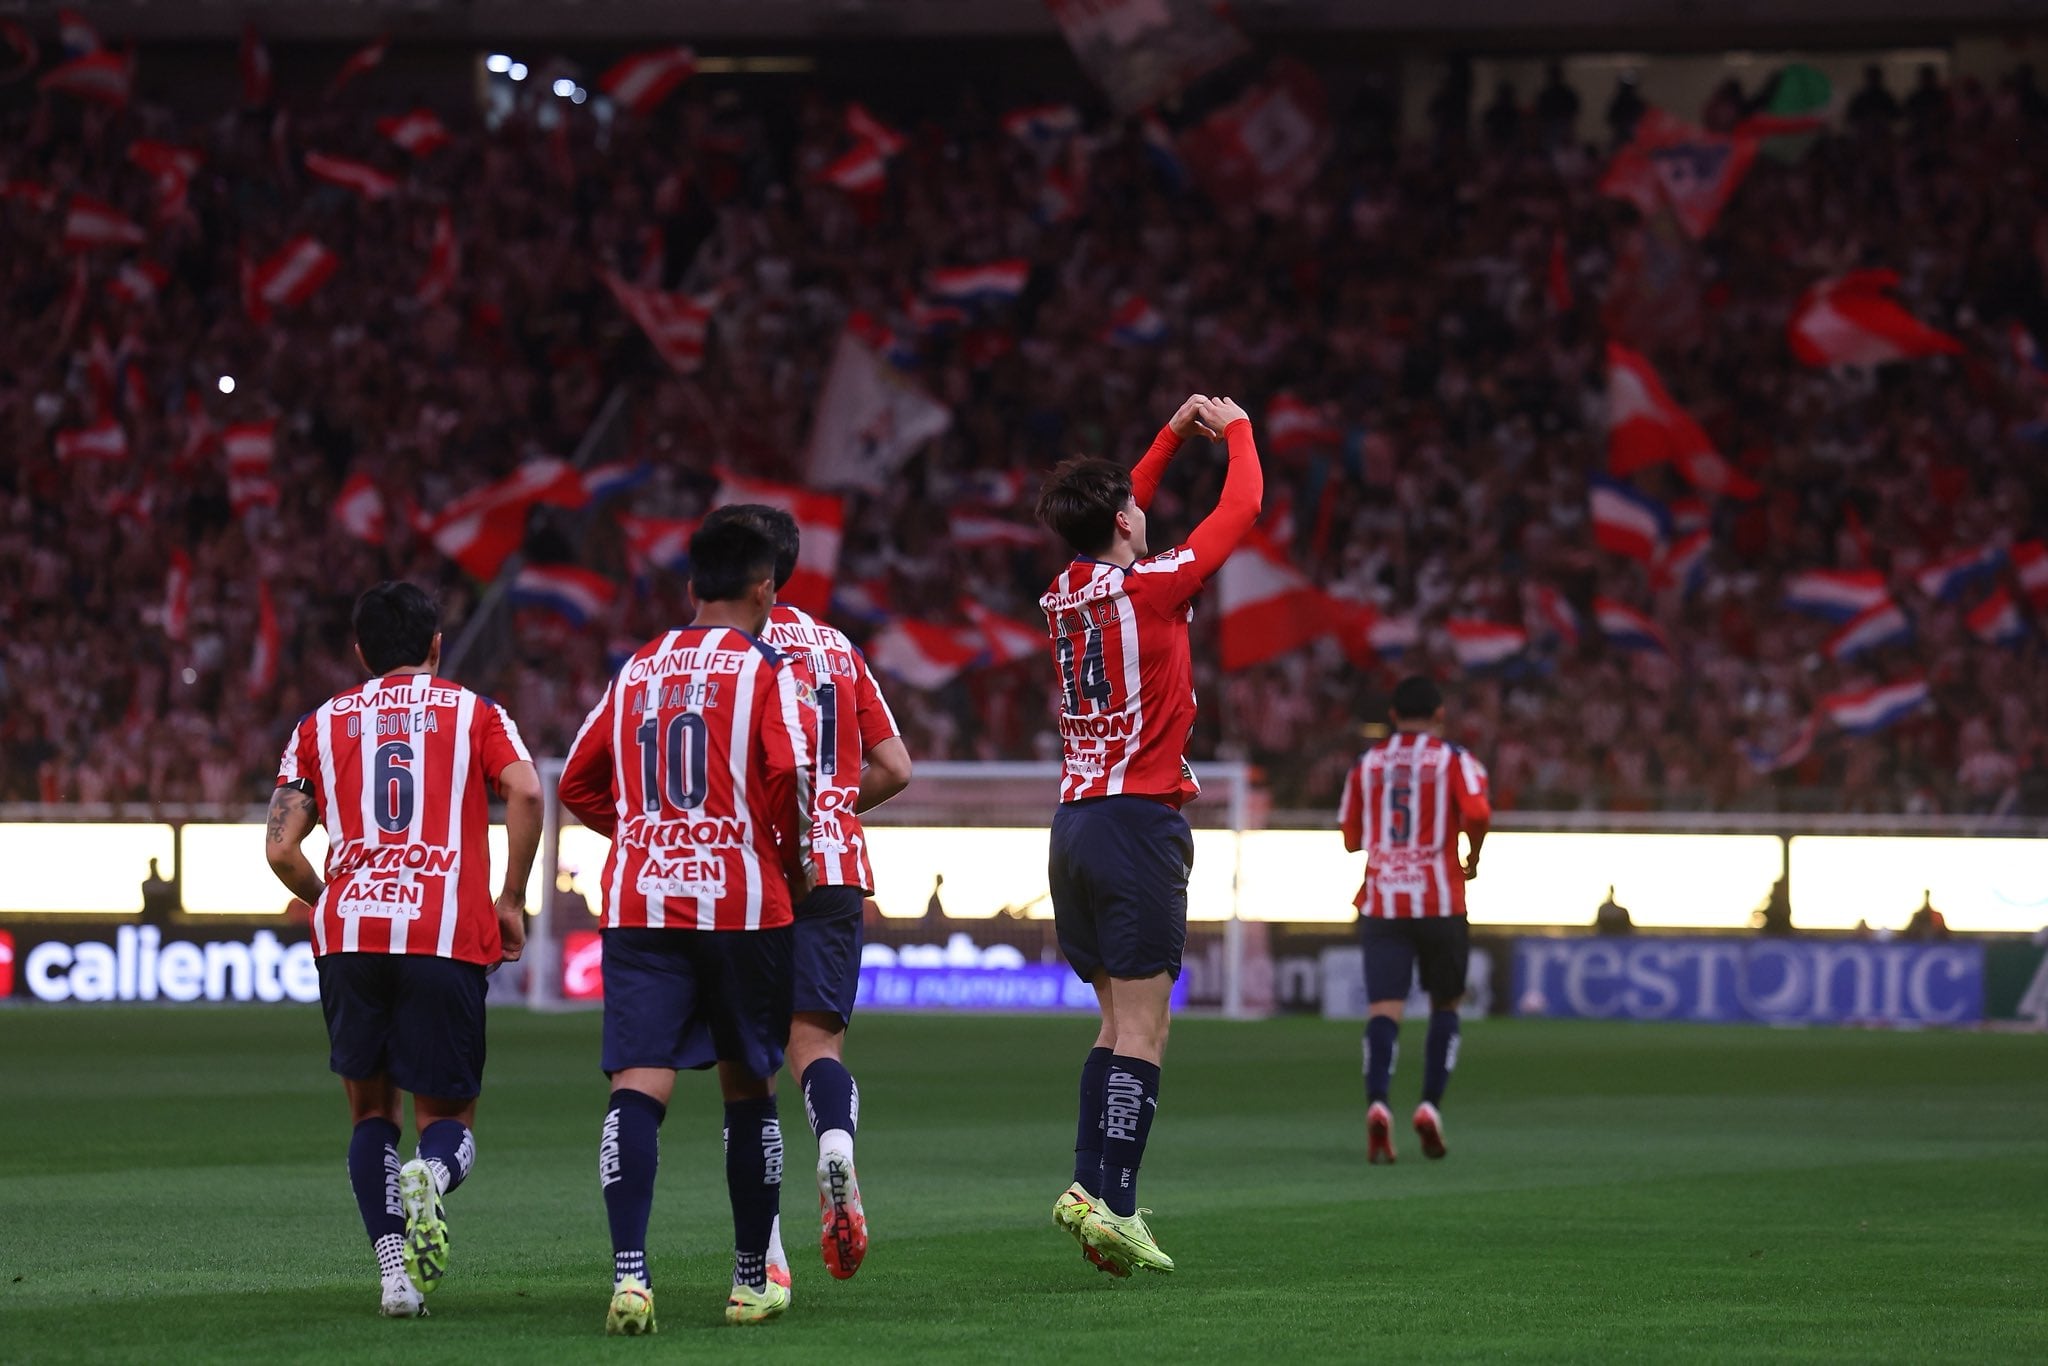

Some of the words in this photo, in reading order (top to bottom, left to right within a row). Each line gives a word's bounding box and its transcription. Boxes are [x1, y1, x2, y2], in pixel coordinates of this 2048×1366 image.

[760, 626, 843, 649] MNILIFE
[630, 651, 736, 681] OMNILIFE
[333, 688, 454, 711] OMNILIFE
[632, 683, 719, 716] ALVAREZ
[376, 711, 437, 736] GOVEA
[637, 712, 709, 812] 10
[374, 742, 414, 833] 6
[1388, 787, 1411, 843] 5
[620, 820, 747, 848] AKRON
[334, 844, 458, 874] AKRON
[643, 859, 722, 882] AXEN
[343, 883, 419, 904] AXEN
[640, 881, 721, 894] CAPITAL
[340, 904, 417, 916] CAPITAL
[25, 924, 321, 1002] caliente
[1106, 1065, 1144, 1141] PERDUR
